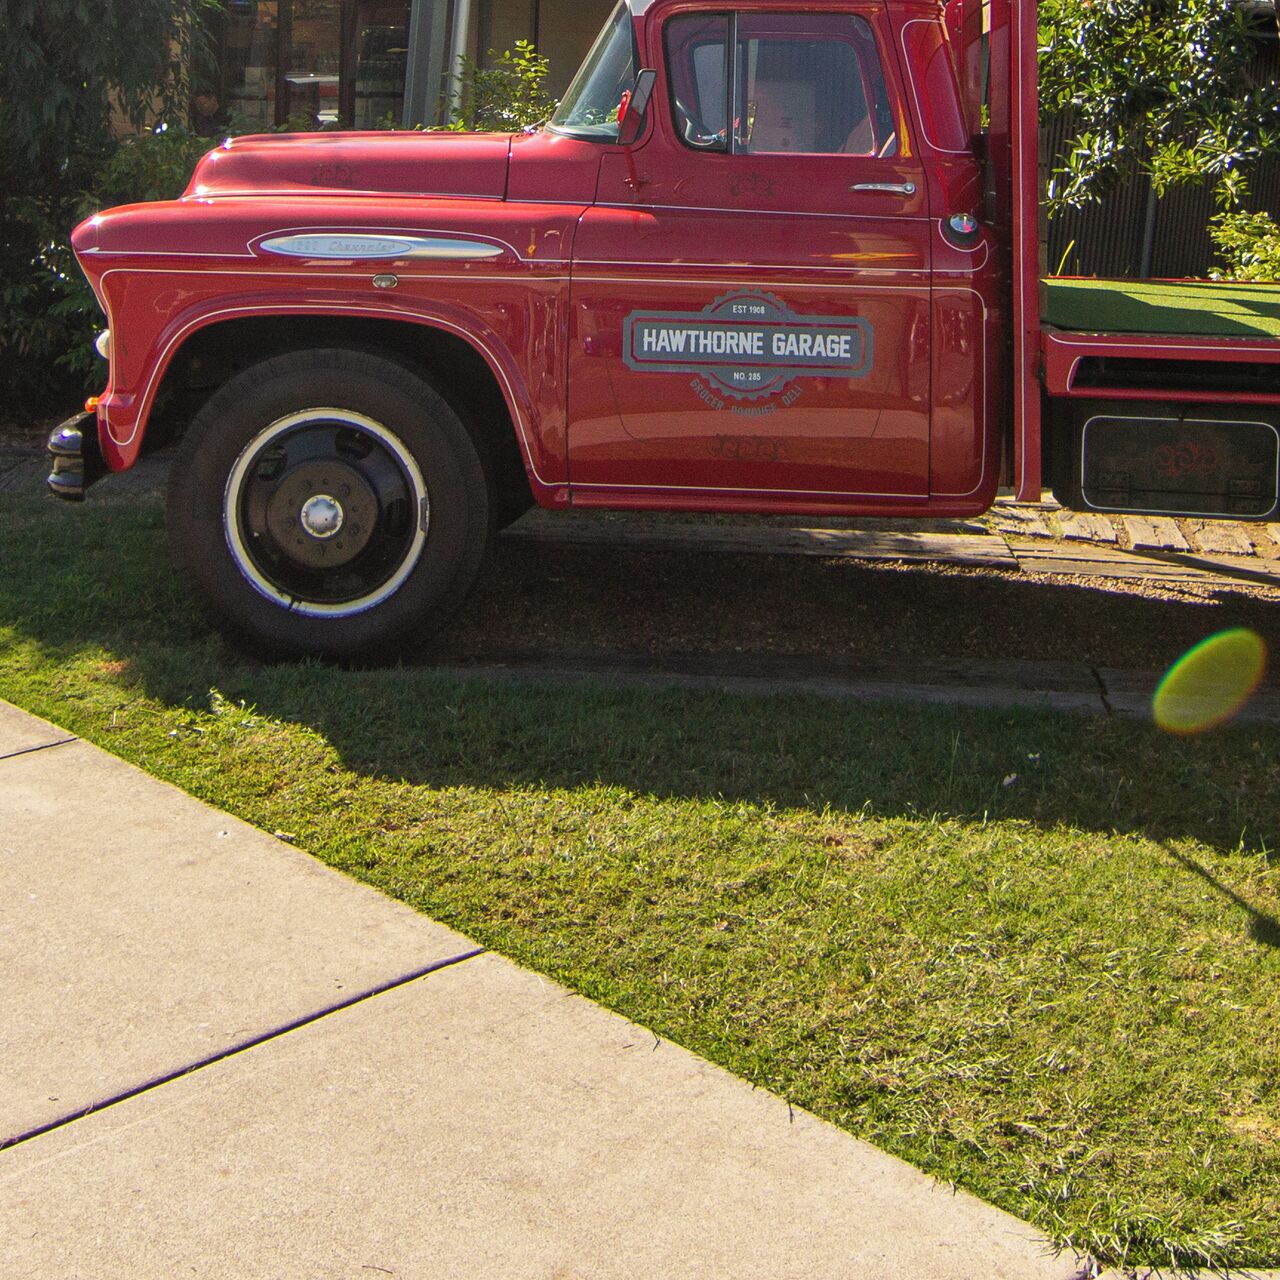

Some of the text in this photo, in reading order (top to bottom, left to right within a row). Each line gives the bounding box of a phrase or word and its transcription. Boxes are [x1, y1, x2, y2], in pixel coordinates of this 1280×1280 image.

[732, 305, 765, 314] EST 1908
[643, 328, 851, 358] HAWTHORNE GARAGE
[781, 385, 803, 406] DELI
